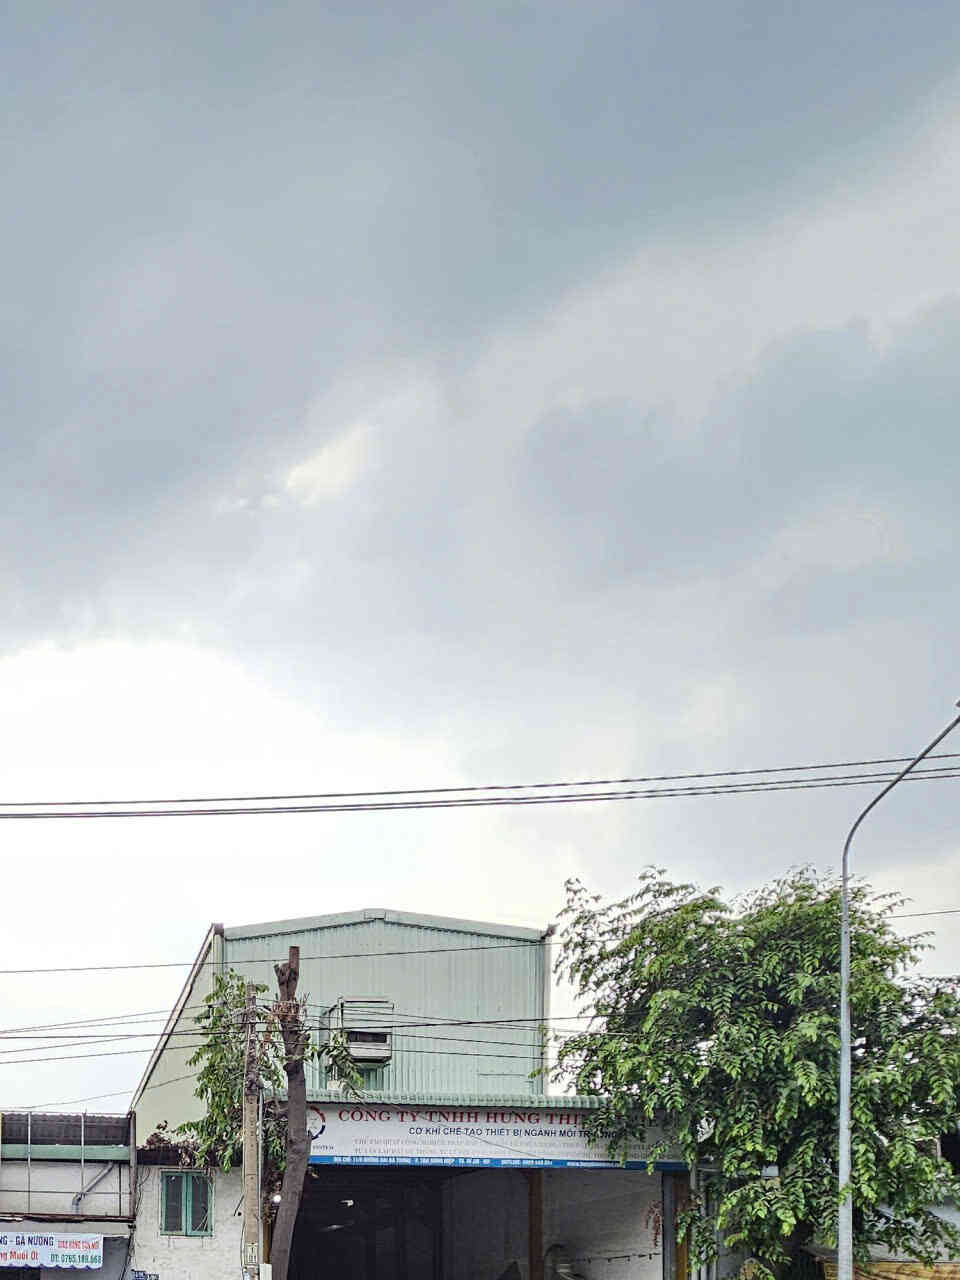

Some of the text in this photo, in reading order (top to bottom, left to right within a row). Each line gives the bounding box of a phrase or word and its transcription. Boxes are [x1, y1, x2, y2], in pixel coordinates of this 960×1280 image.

[338, 1107, 391, 1122] CÔNG
[397, 1111, 419, 1122] TY
[428, 1110, 479, 1124] TNHH
